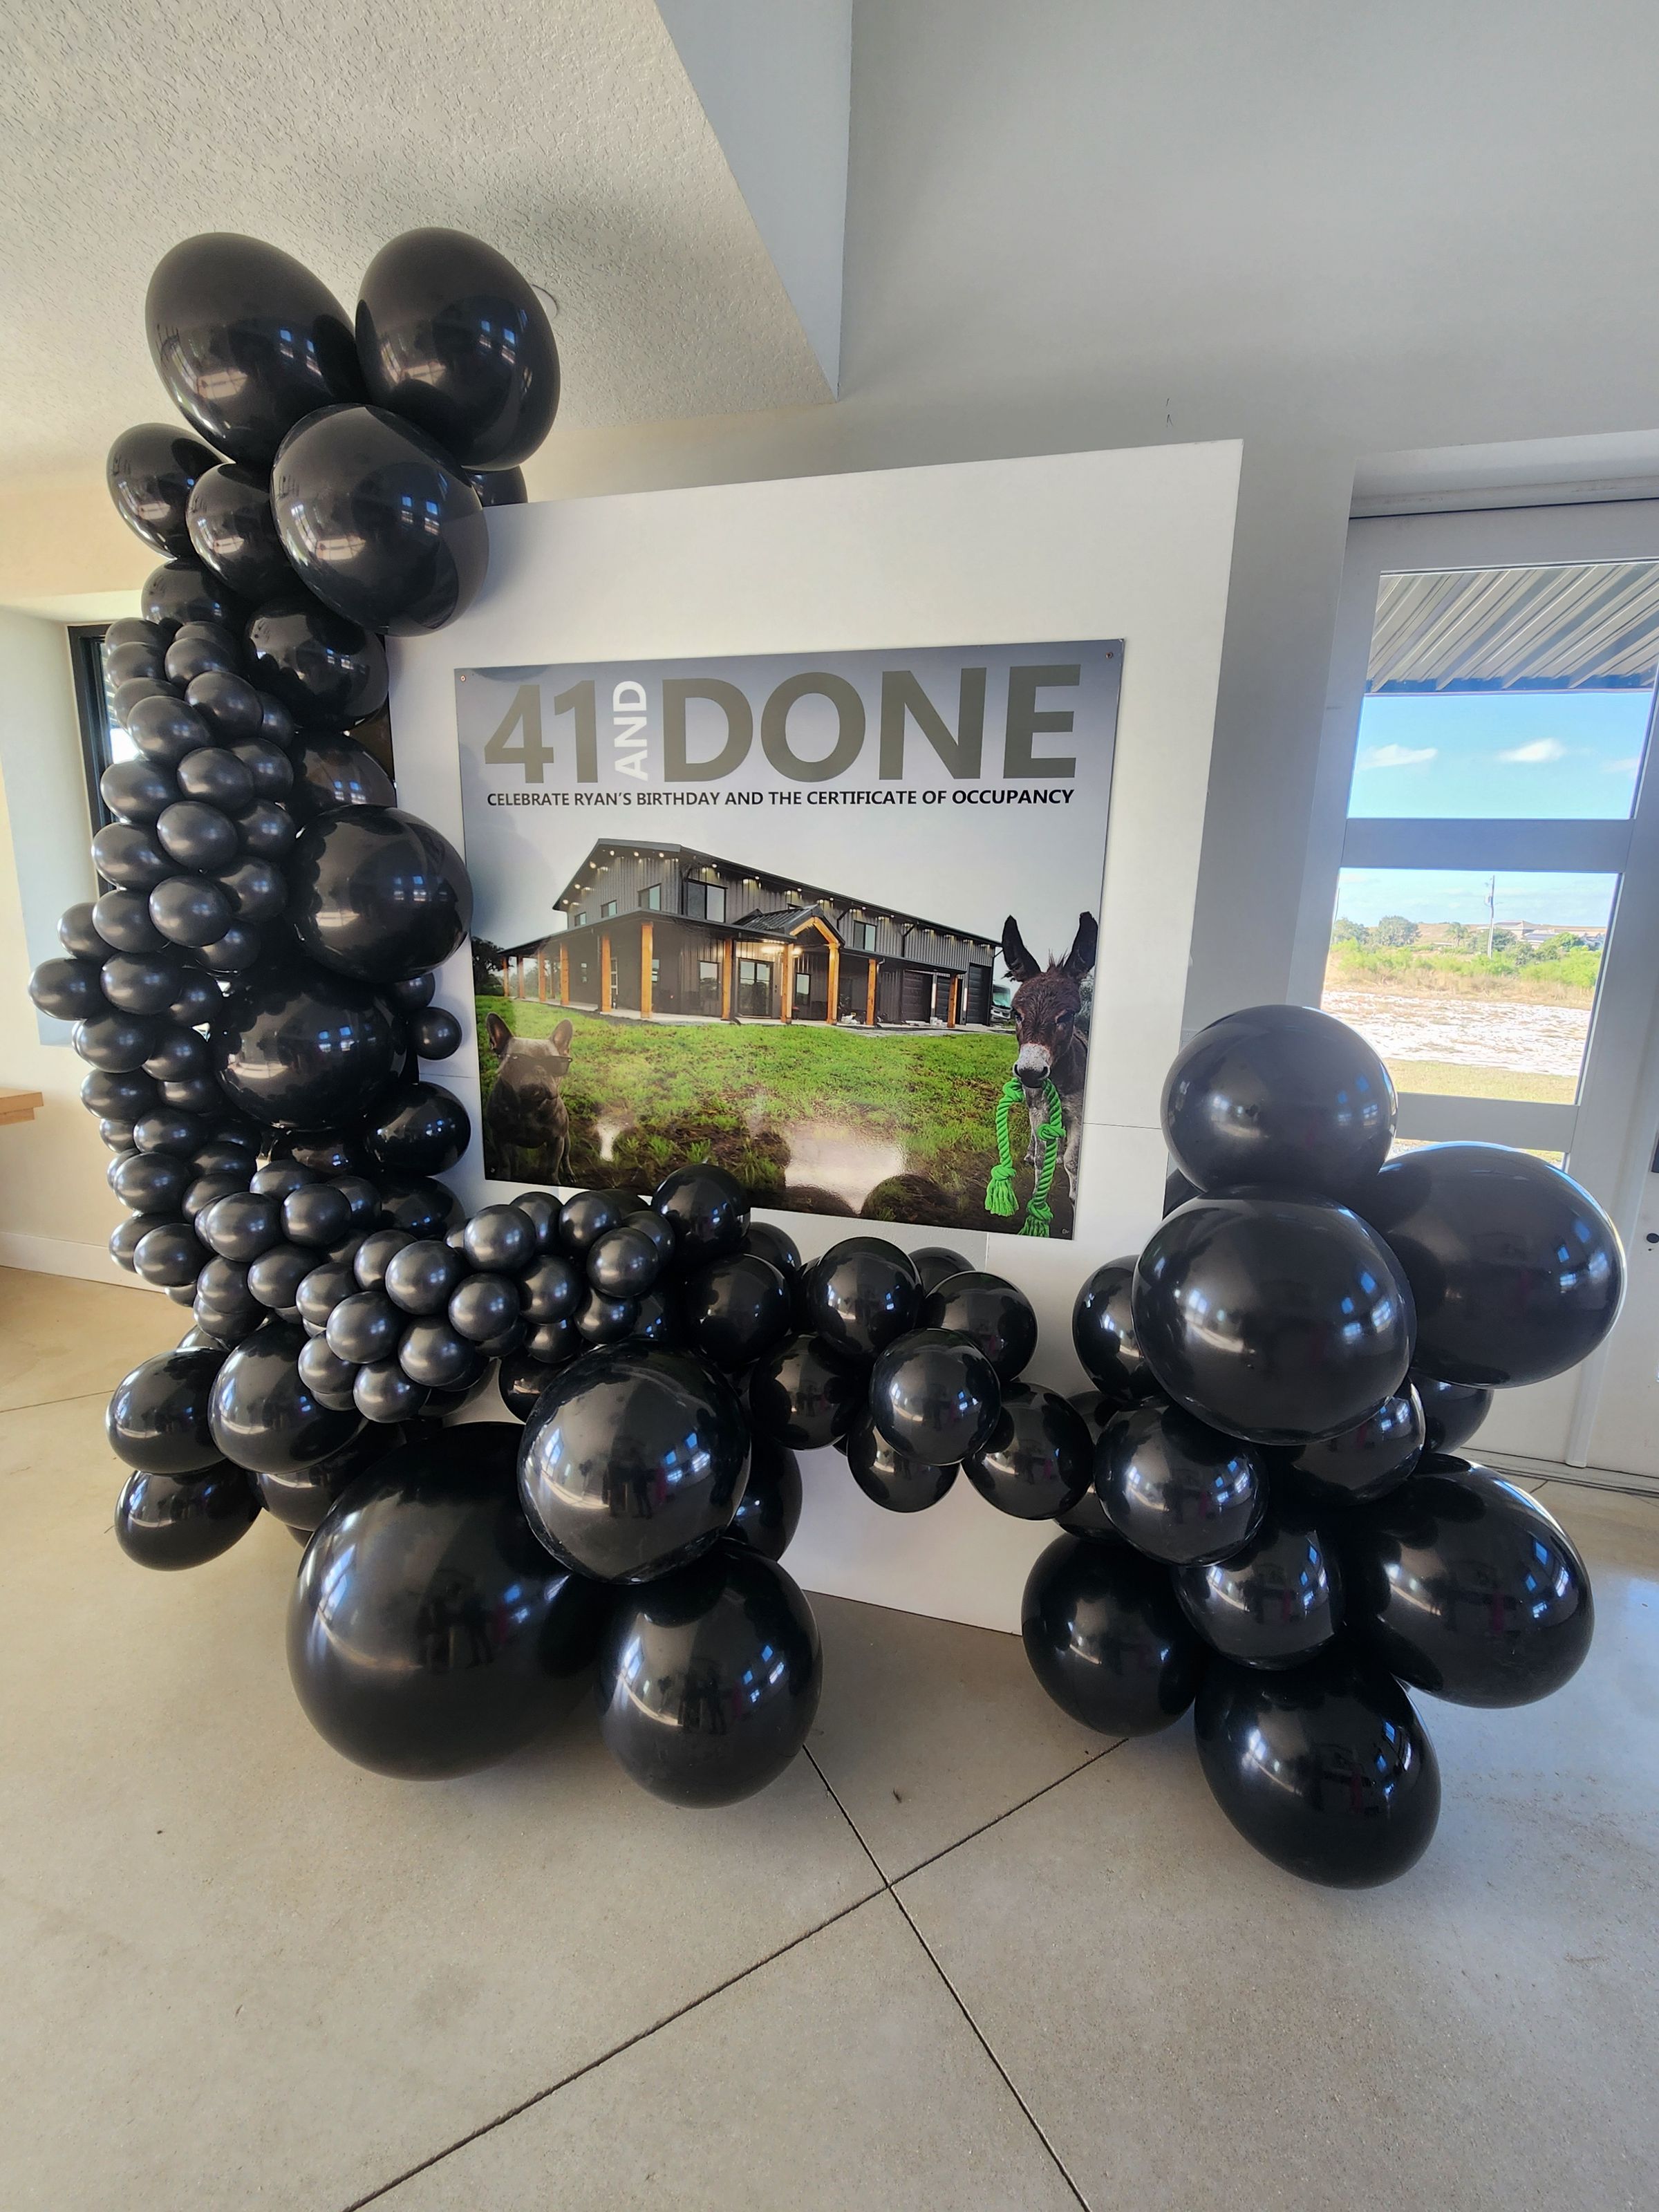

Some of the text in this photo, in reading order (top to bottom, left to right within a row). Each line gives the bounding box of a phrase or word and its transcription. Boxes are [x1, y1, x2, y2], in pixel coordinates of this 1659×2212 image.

[485, 664, 1081, 784] 41 AND DONE
[487, 789, 1075, 807] CELEBRATE RYAN'S BIRTHDAY AND THE CERTIFICATE OF OCCUPANCY
